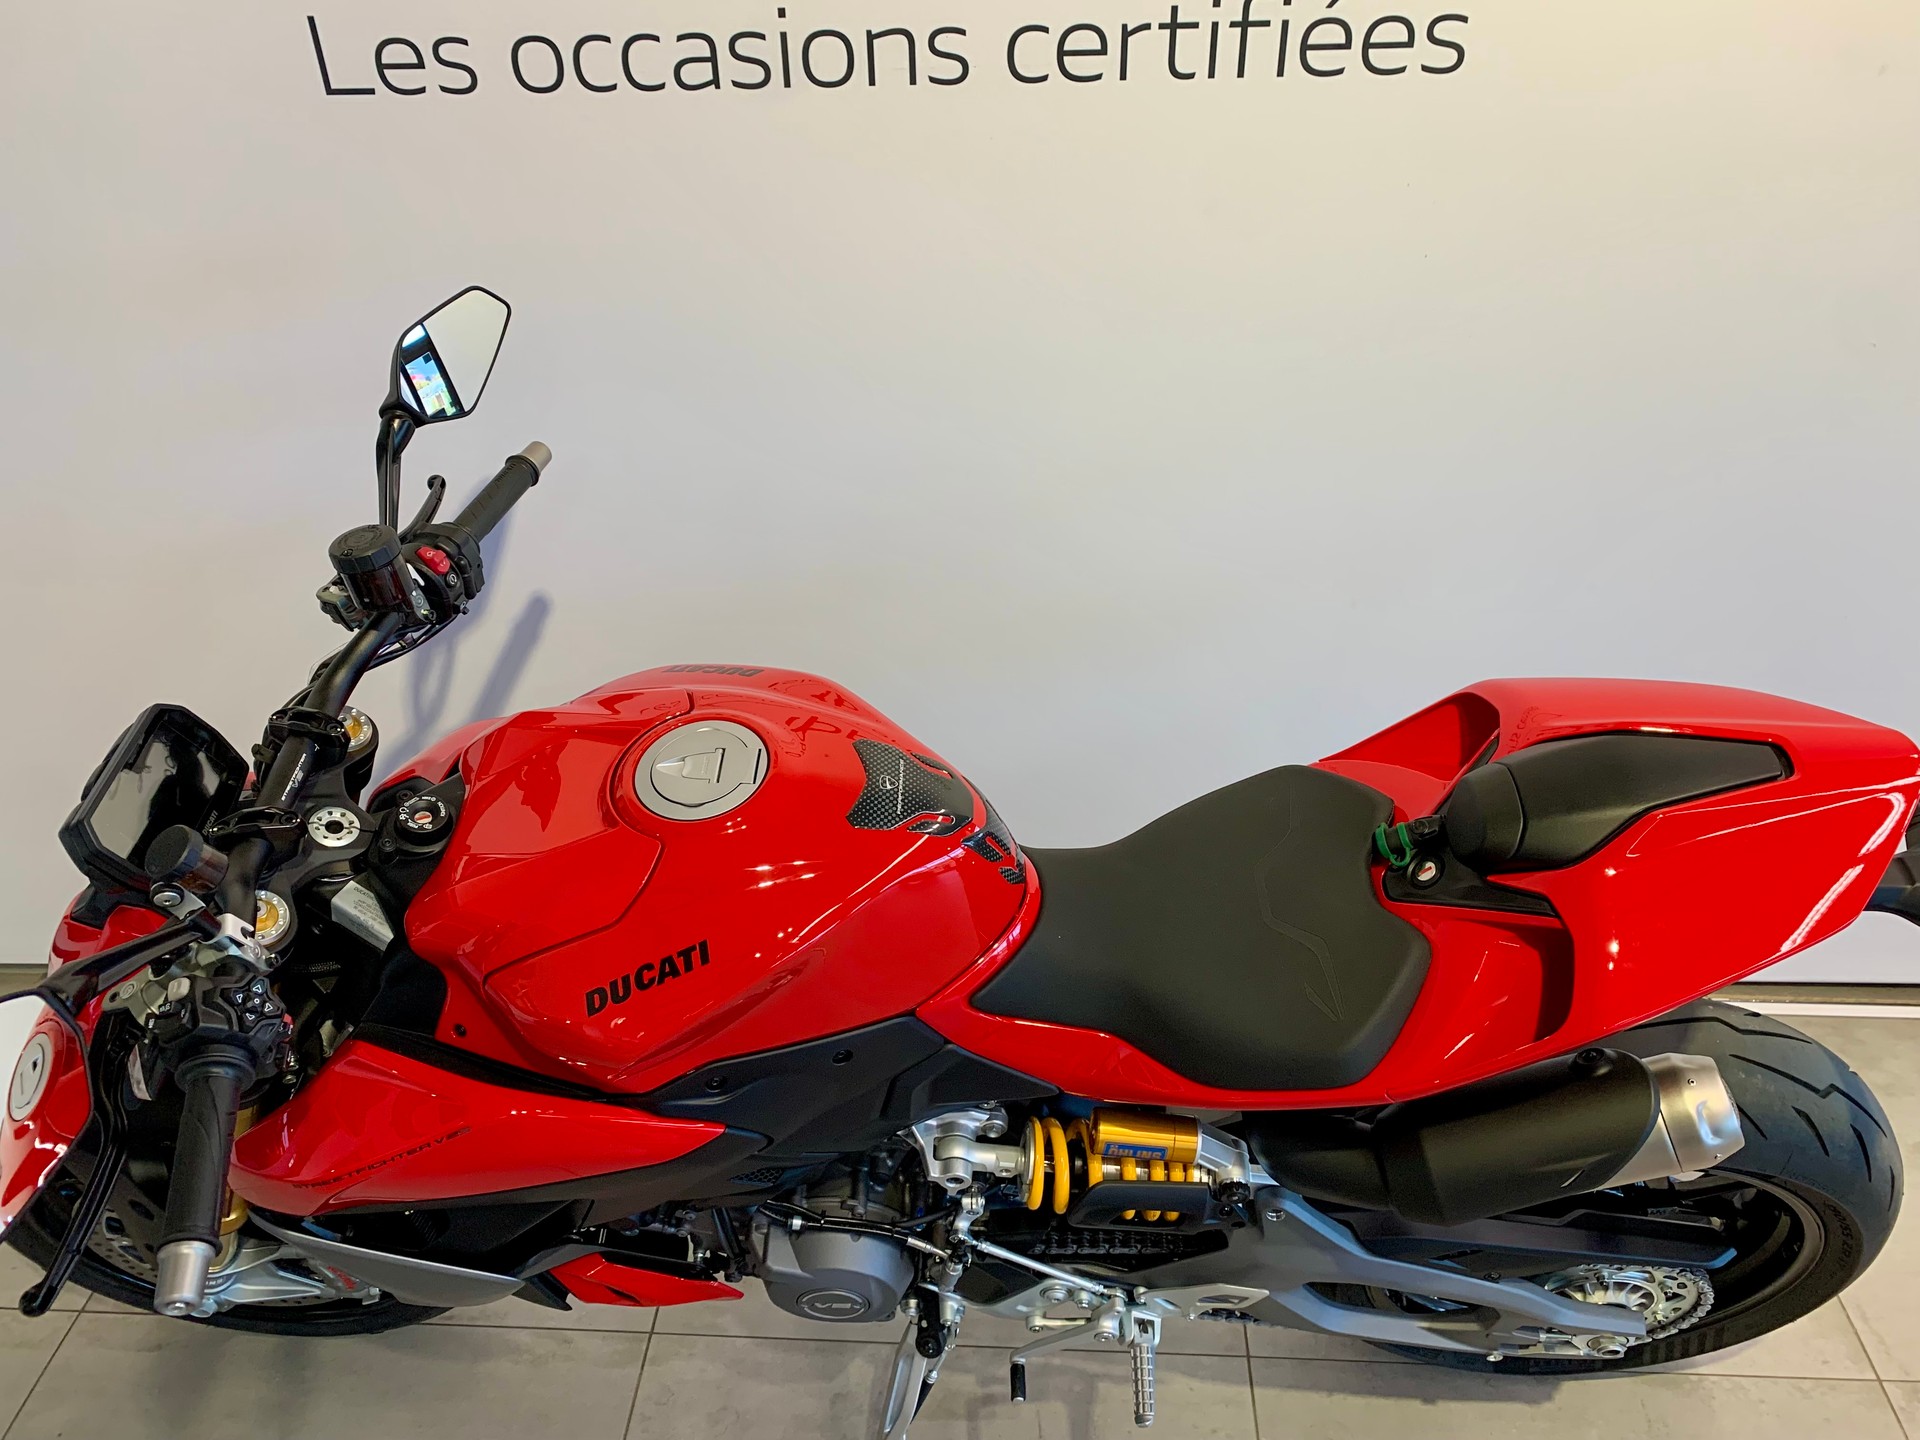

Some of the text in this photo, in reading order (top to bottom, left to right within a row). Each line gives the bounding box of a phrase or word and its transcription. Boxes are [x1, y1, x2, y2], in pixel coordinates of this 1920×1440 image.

[306, 0, 1469, 96] Les occasions certifiées
[585, 938, 711, 1018] DUCATI
